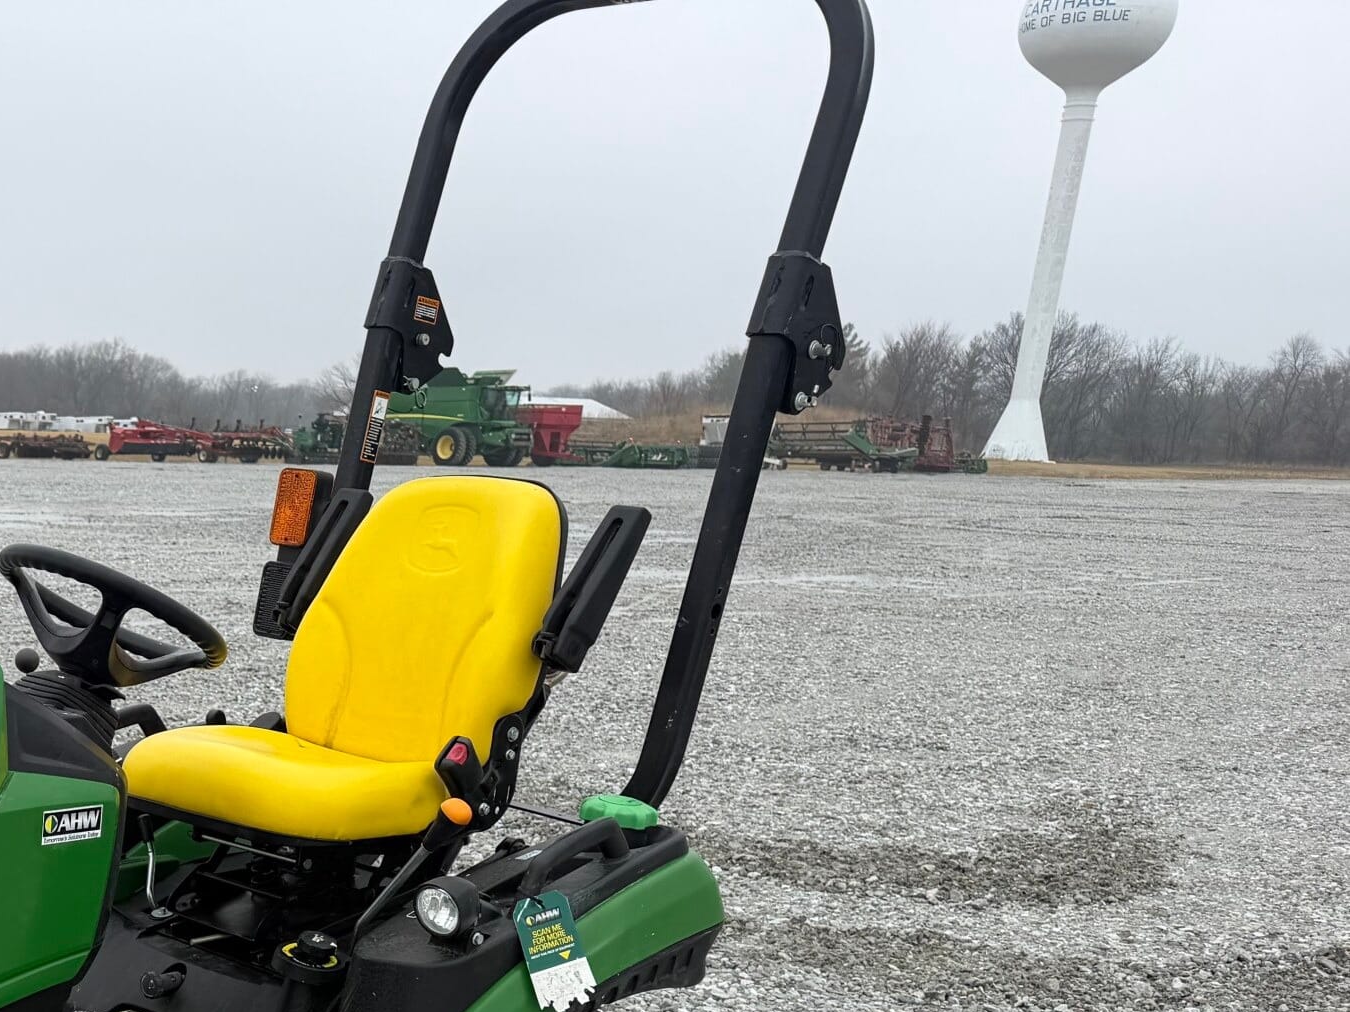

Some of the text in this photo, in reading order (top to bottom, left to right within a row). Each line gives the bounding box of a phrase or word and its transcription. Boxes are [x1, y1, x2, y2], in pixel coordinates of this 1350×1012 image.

[1040, 14, 1056, 28] OF
[1061, 11, 1087, 24] BIG
[1093, 9, 1131, 21] BLUE
[57, 809, 100, 832] AHW
[535, 907, 560, 923] AHW
[532, 922, 563, 938] SCAN ME
[532, 929, 567, 946] FOR MORE
[529, 934, 574, 955] INFORMATION
